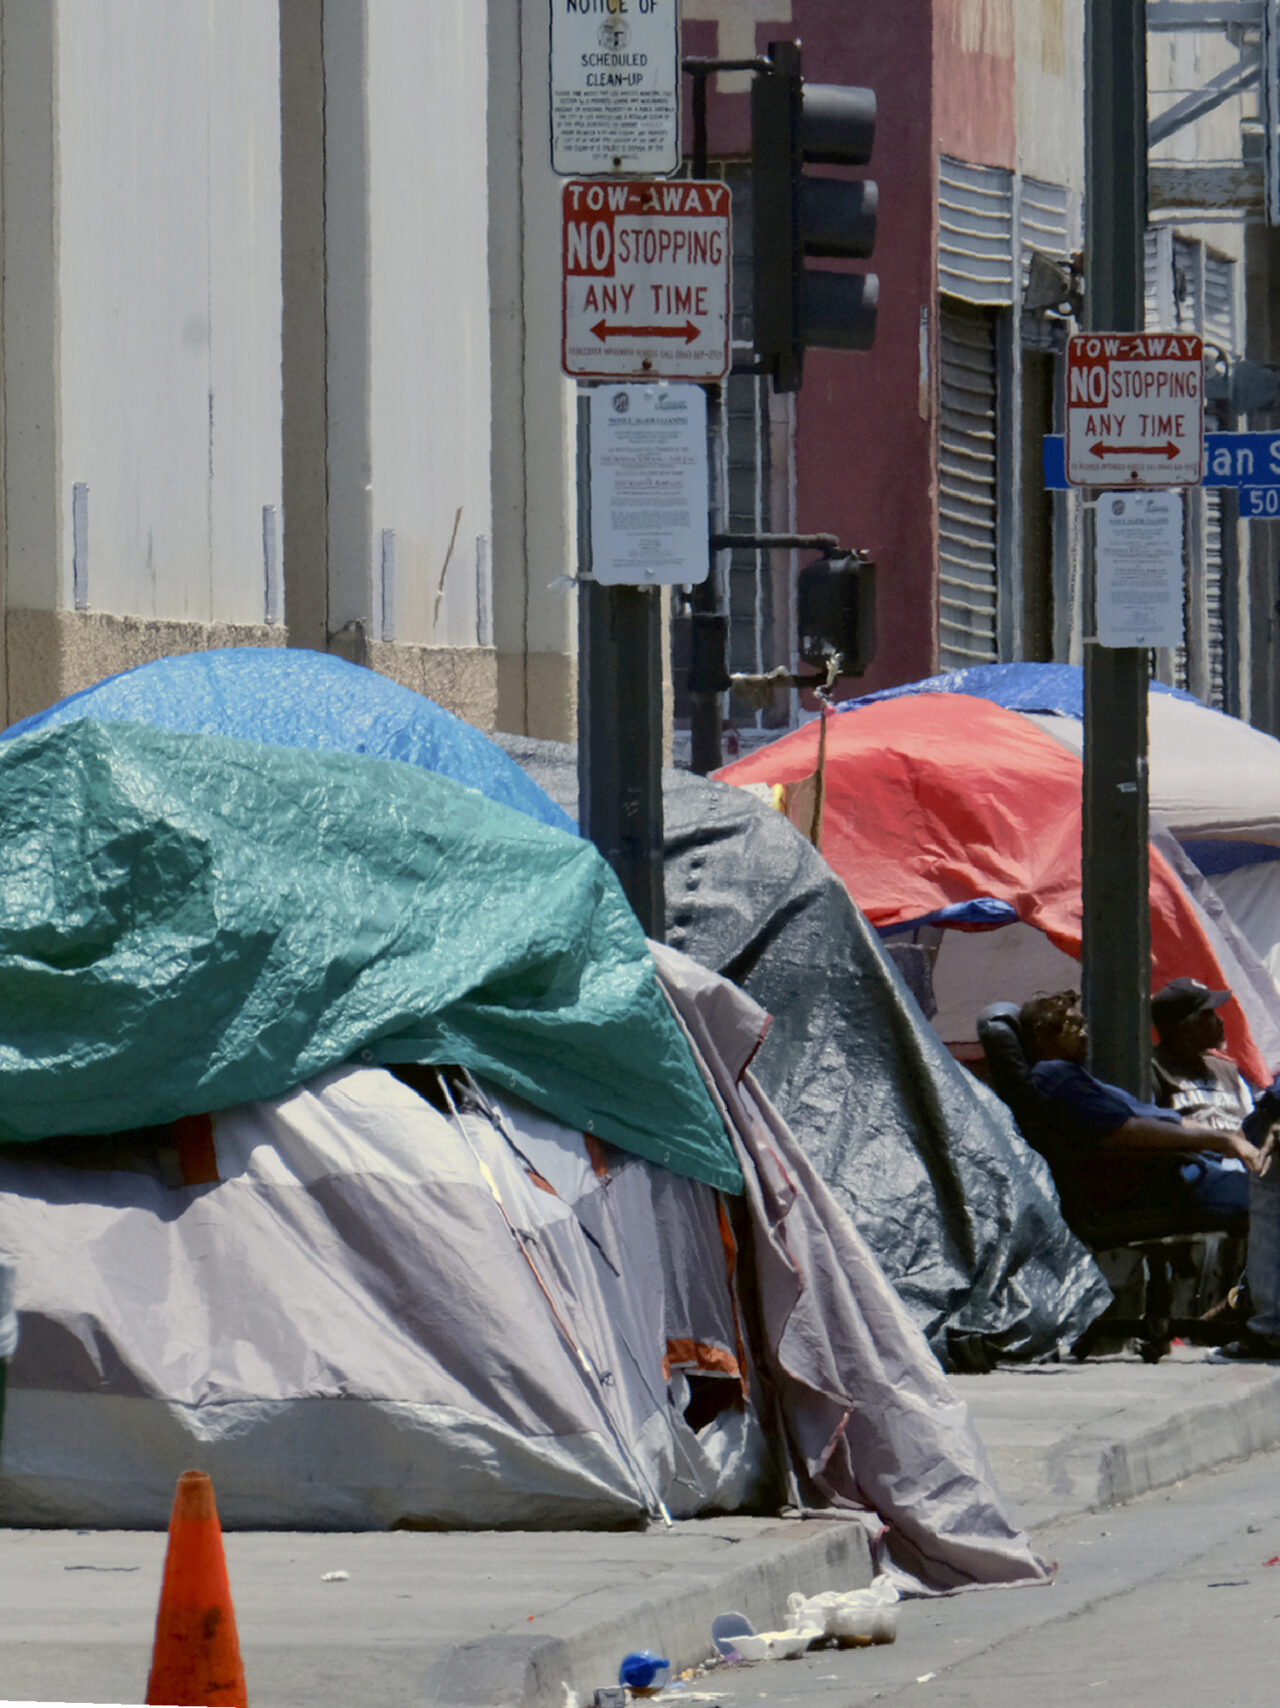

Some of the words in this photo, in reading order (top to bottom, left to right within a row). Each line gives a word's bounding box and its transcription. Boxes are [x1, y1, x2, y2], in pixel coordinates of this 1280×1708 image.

[566, 0, 628, 14] NOTICE
[639, 0, 659, 14] OF
[581, 53, 648, 67] SCHEDULED
[586, 73, 644, 87] CLEAN-UP
[568, 186, 723, 212] TOW-AWAY
[567, 221, 611, 270] NO
[618, 229, 723, 265] STOPPING
[583, 284, 635, 314] ANY
[651, 284, 709, 316] TIME
[1073, 337, 1197, 357] TOW-AWAY
[1070, 364, 1107, 403] NO
[1111, 370, 1197, 399] STOPPING
[1084, 414, 1125, 437] ANY
[1139, 413, 1186, 438] TIME
